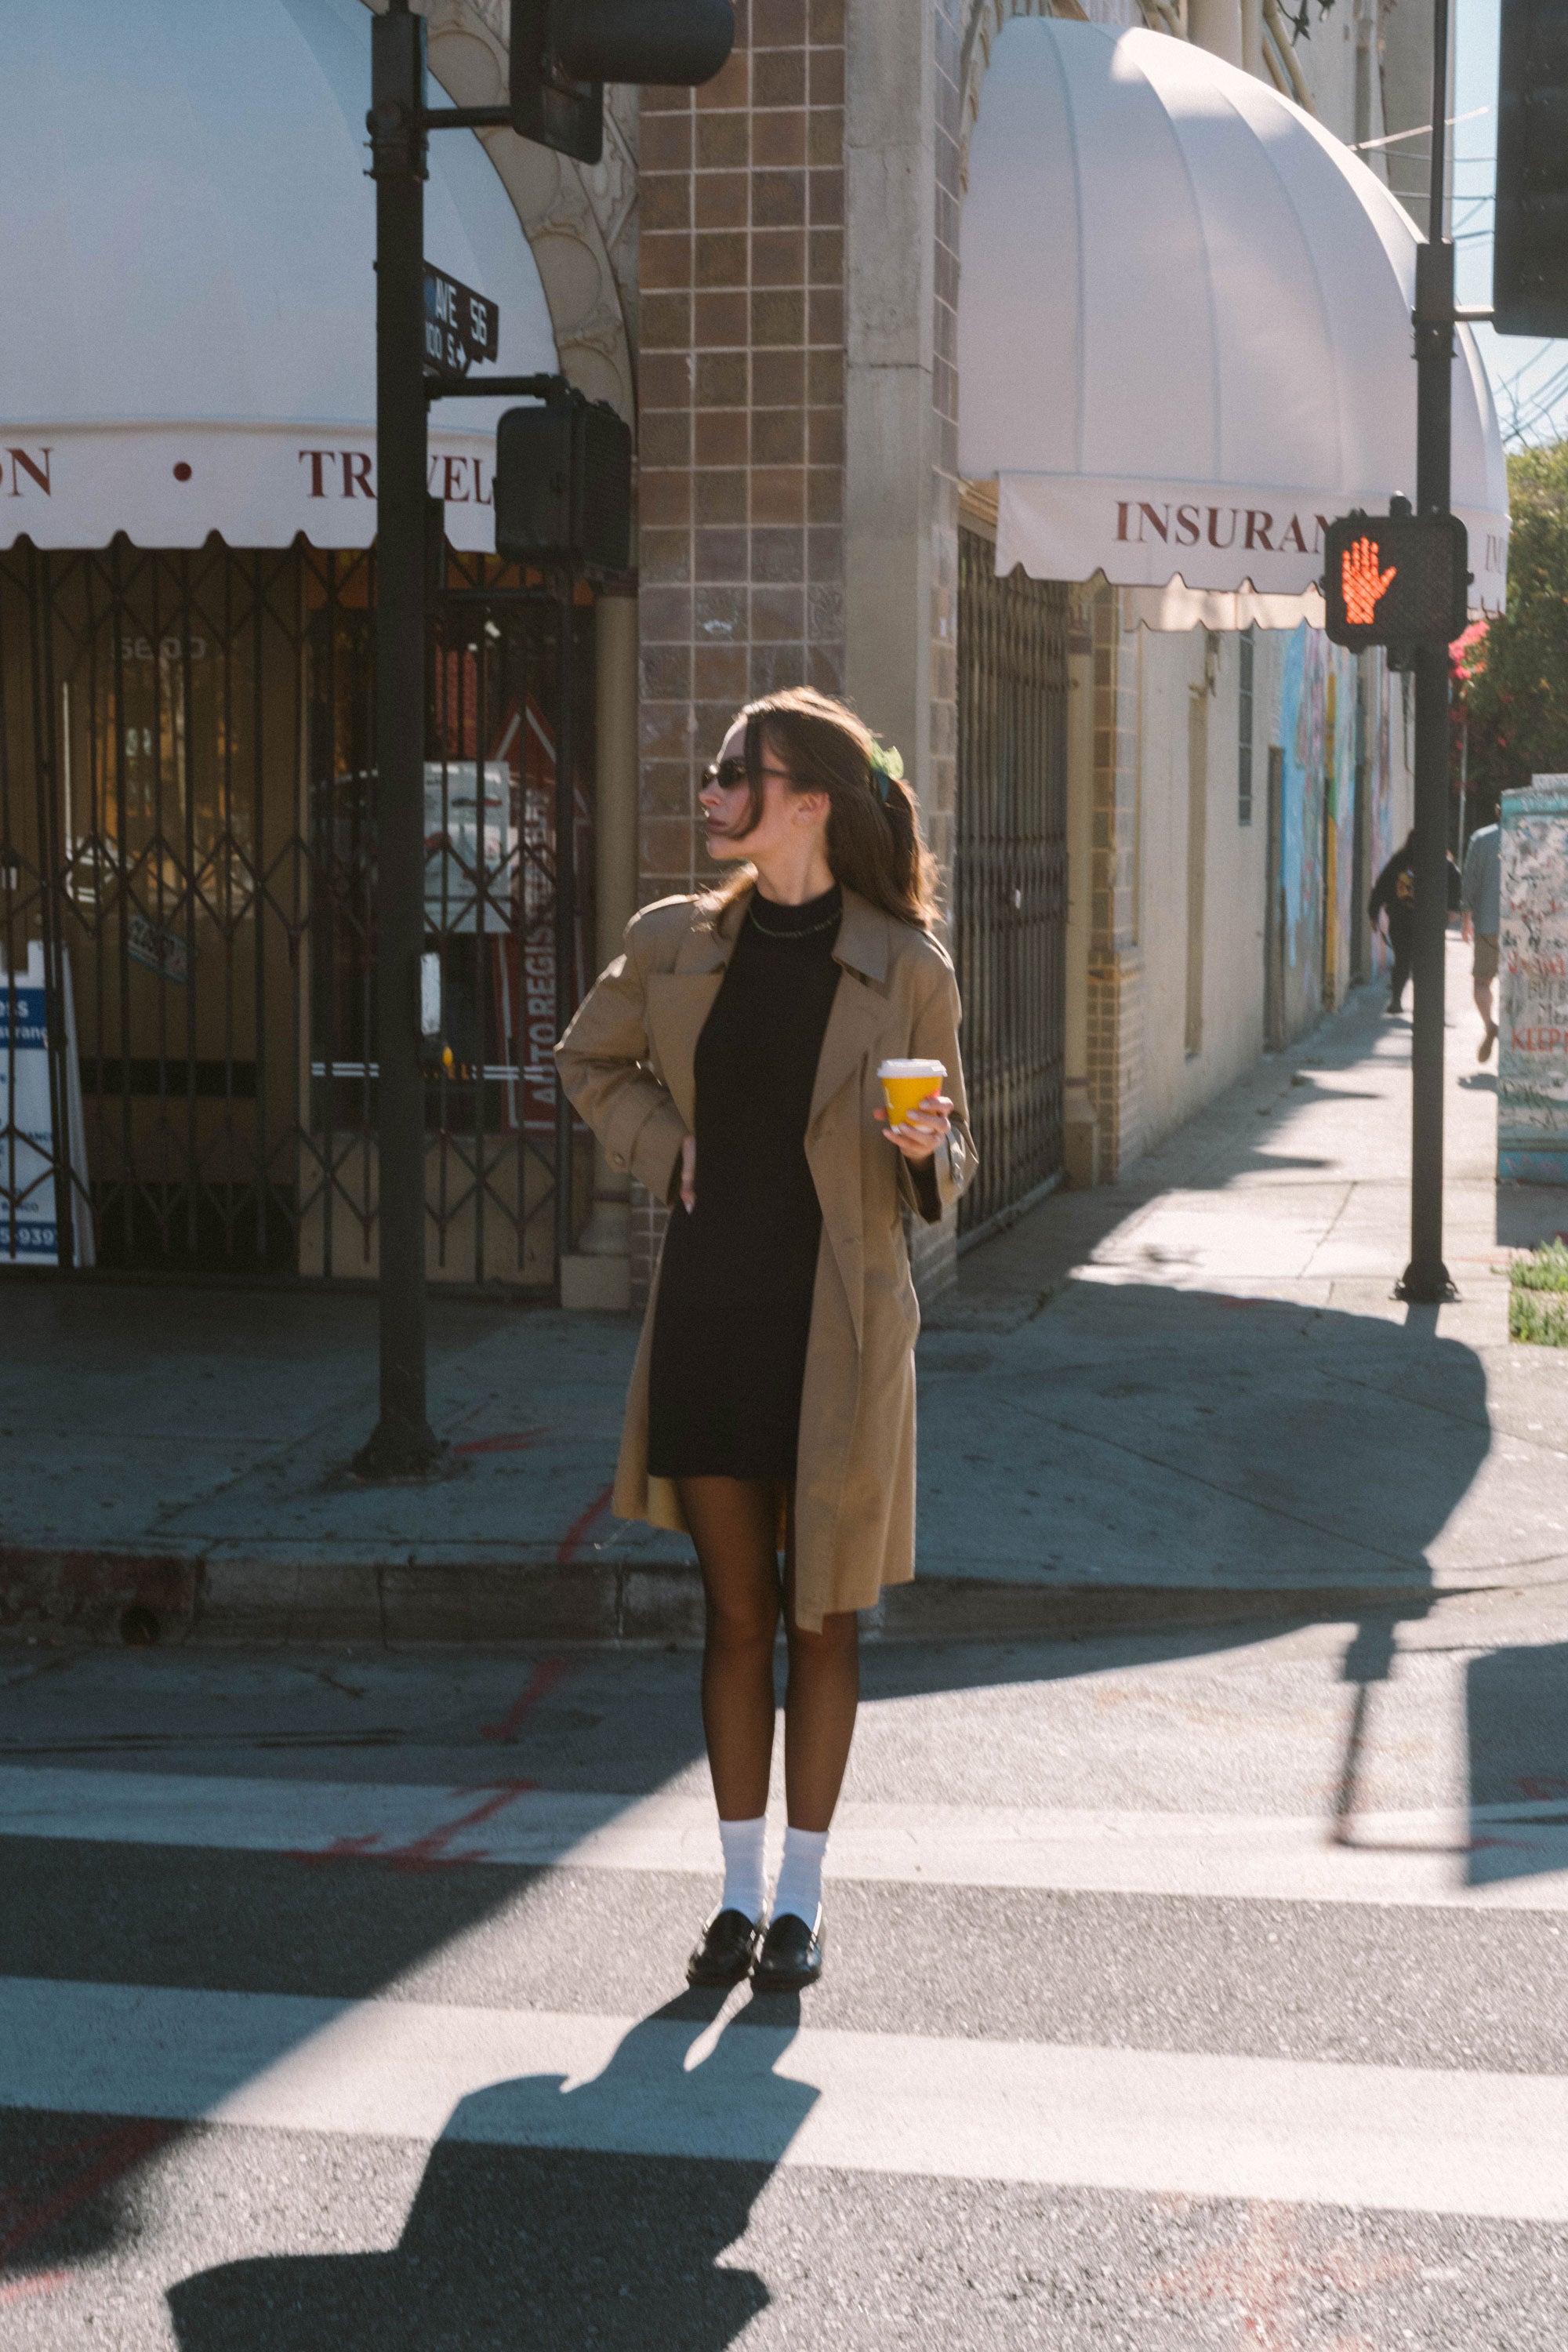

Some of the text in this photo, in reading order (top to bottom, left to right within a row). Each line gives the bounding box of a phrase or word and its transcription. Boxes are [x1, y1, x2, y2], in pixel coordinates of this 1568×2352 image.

[435, 277, 488, 347] AVE 56
[0, 448, 492, 505] N TREL
[528, 1022, 556, 1106] AUTO
[1510, 1026, 1562, 1053] KEEP
